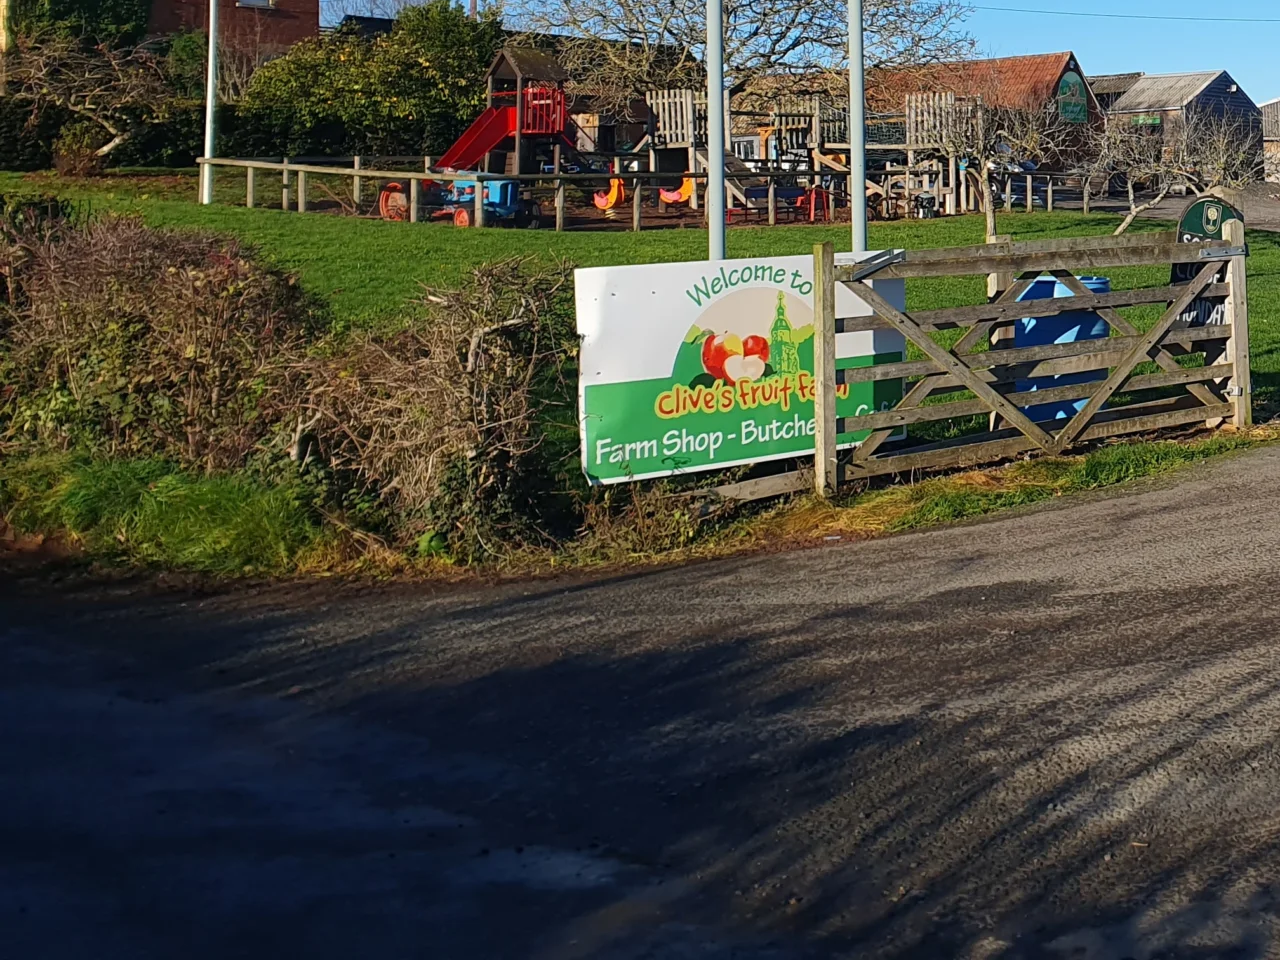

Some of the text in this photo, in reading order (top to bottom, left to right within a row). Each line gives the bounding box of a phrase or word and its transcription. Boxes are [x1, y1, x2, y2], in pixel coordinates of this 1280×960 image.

[686, 265, 812, 306] Welcome to
[740, 379, 791, 407] fruit
[596, 437, 658, 464] Farm
[662, 428, 723, 459] Shop
